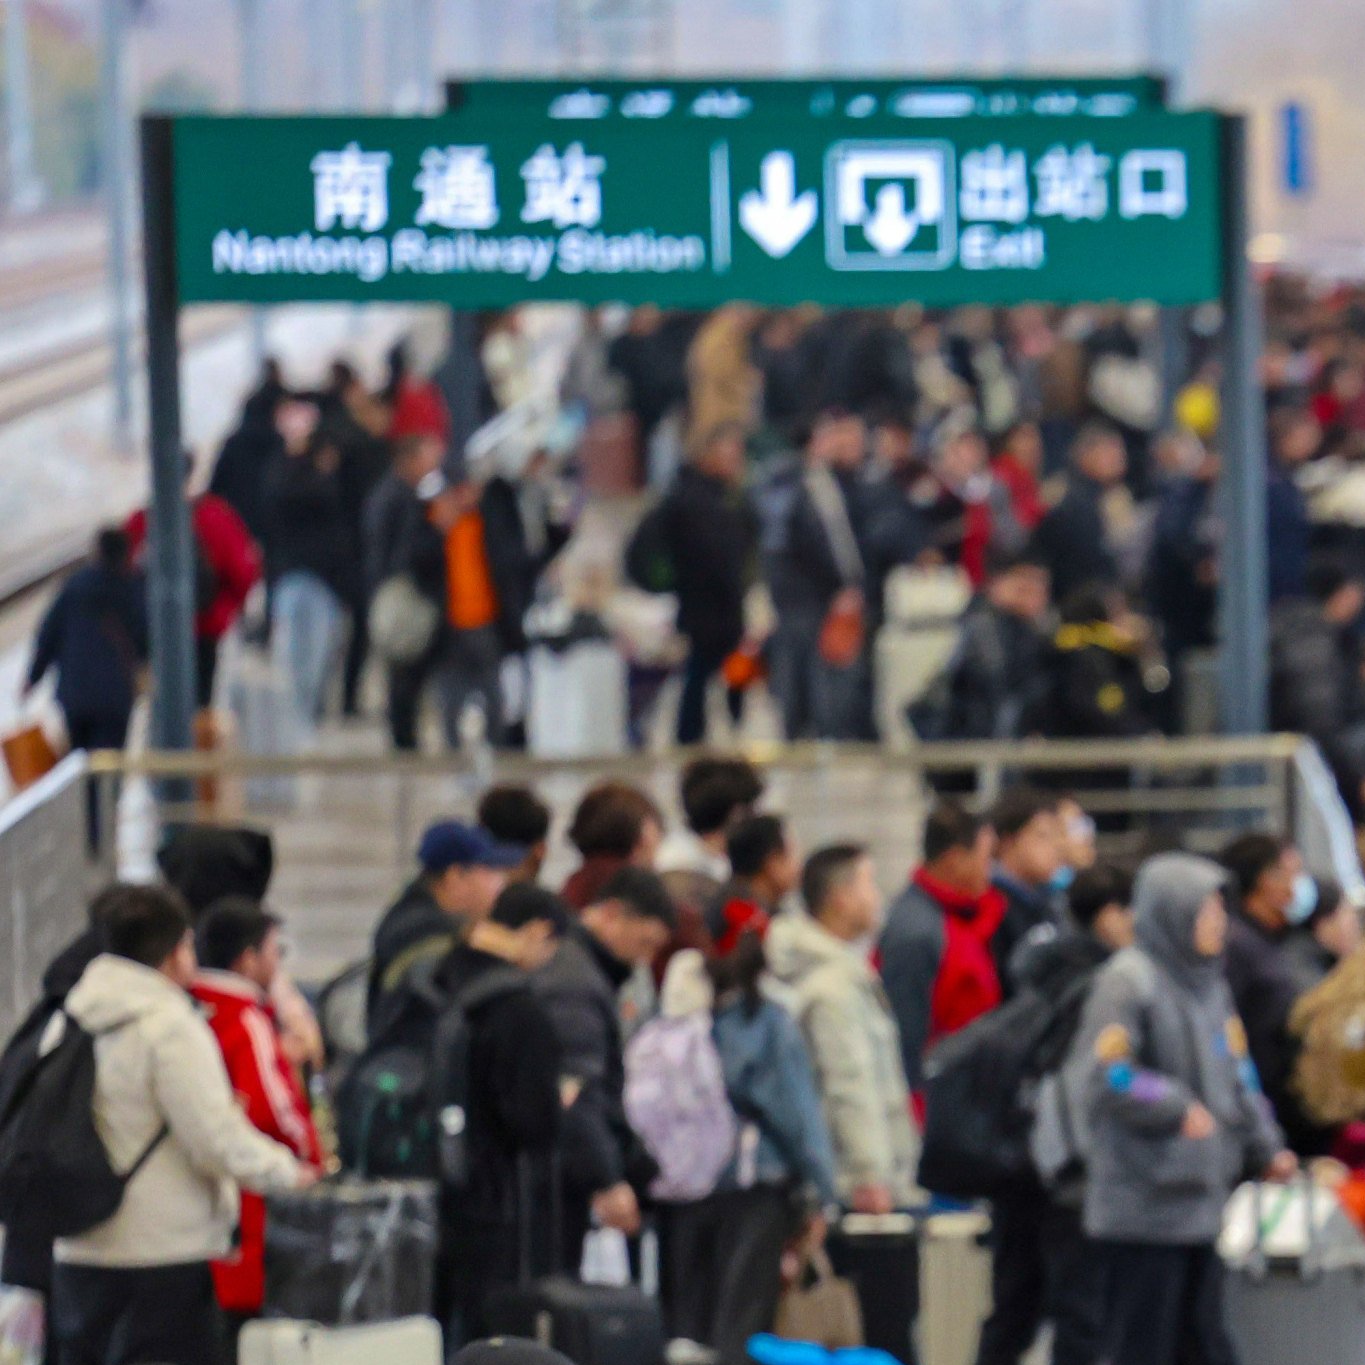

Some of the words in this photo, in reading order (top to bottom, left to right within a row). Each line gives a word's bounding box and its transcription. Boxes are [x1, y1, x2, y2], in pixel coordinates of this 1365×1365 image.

[310, 141, 607, 232] 南通站
[959, 142, 1188, 224] 出站口
[211, 228, 389, 282] Nantong
[390, 227, 555, 282] Railway
[556, 228, 706, 274] Station
[959, 222, 1045, 271] Exit
